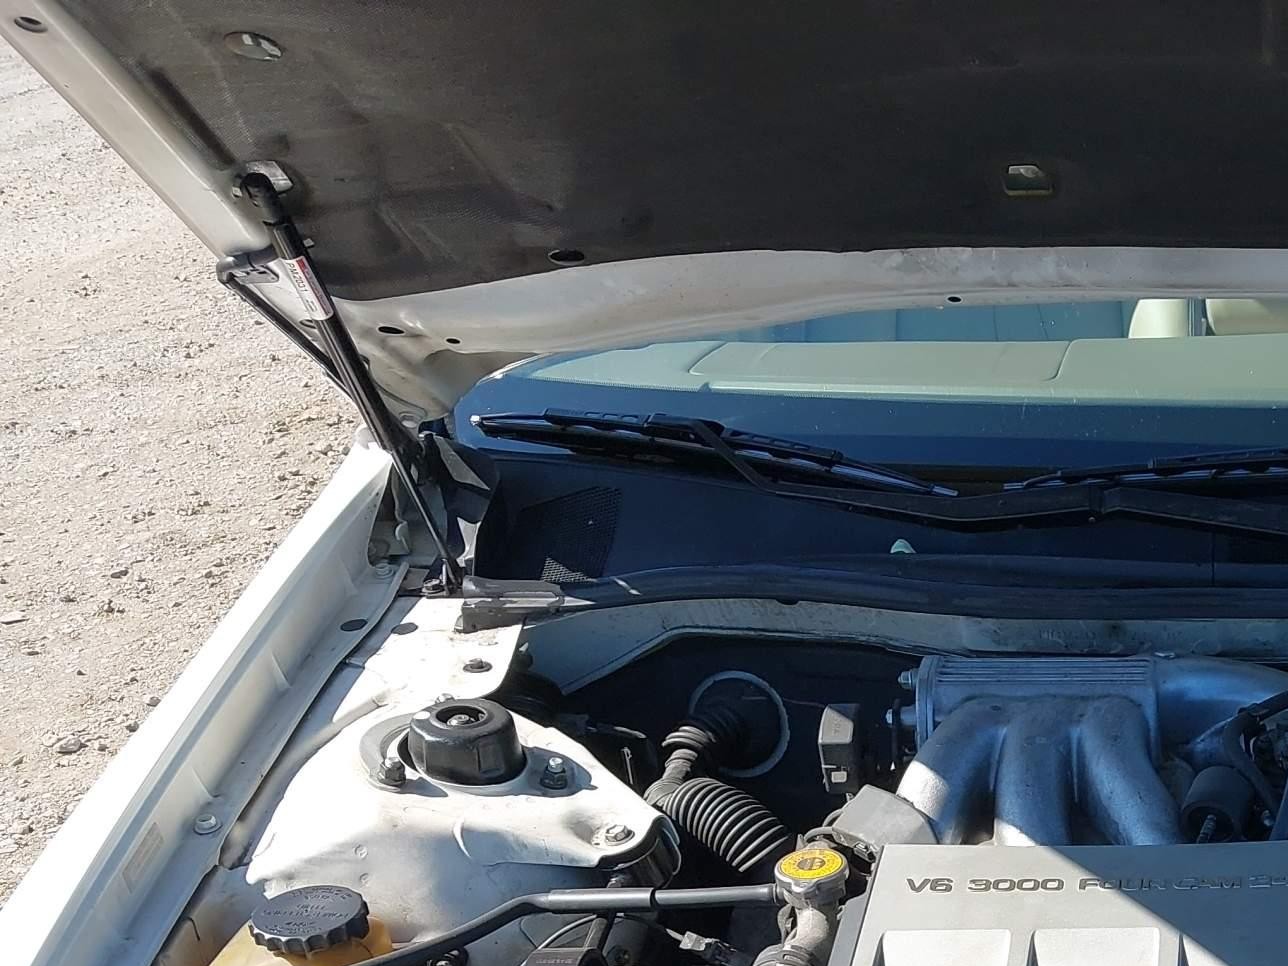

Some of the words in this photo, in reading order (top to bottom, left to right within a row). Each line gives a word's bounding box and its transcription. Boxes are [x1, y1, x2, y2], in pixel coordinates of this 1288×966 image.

[906, 877, 953, 893] V6
[967, 877, 1065, 892] 3000
[1078, 877, 1166, 891] FOUR
[1173, 876, 1242, 890] CAM
